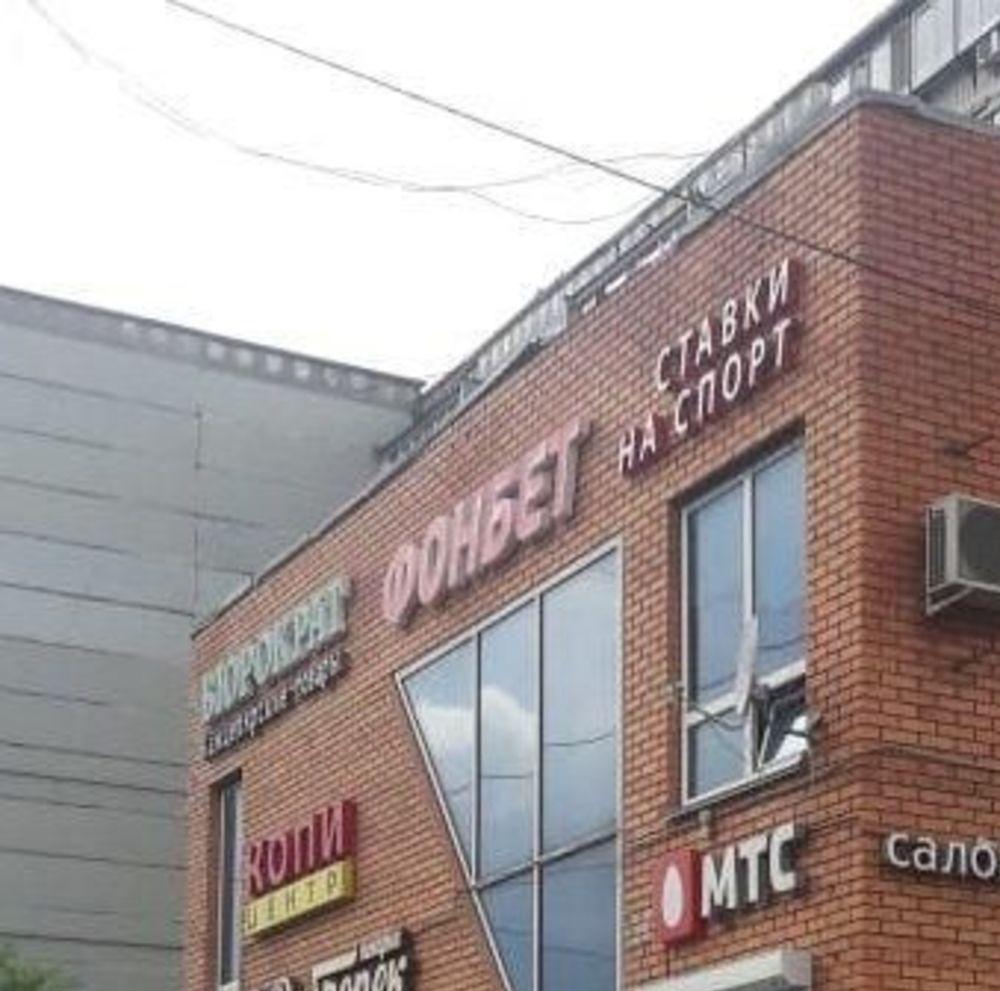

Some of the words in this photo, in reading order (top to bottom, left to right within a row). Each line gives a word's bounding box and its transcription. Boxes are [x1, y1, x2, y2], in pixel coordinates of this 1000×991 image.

[619, 411, 656, 474] НА
[674, 318, 792, 435] СПОРТ
[656, 257, 790, 391] СТАВКИ
[383, 417, 592, 623] ФОНБЕТ
[701, 822, 797, 918] МТС
